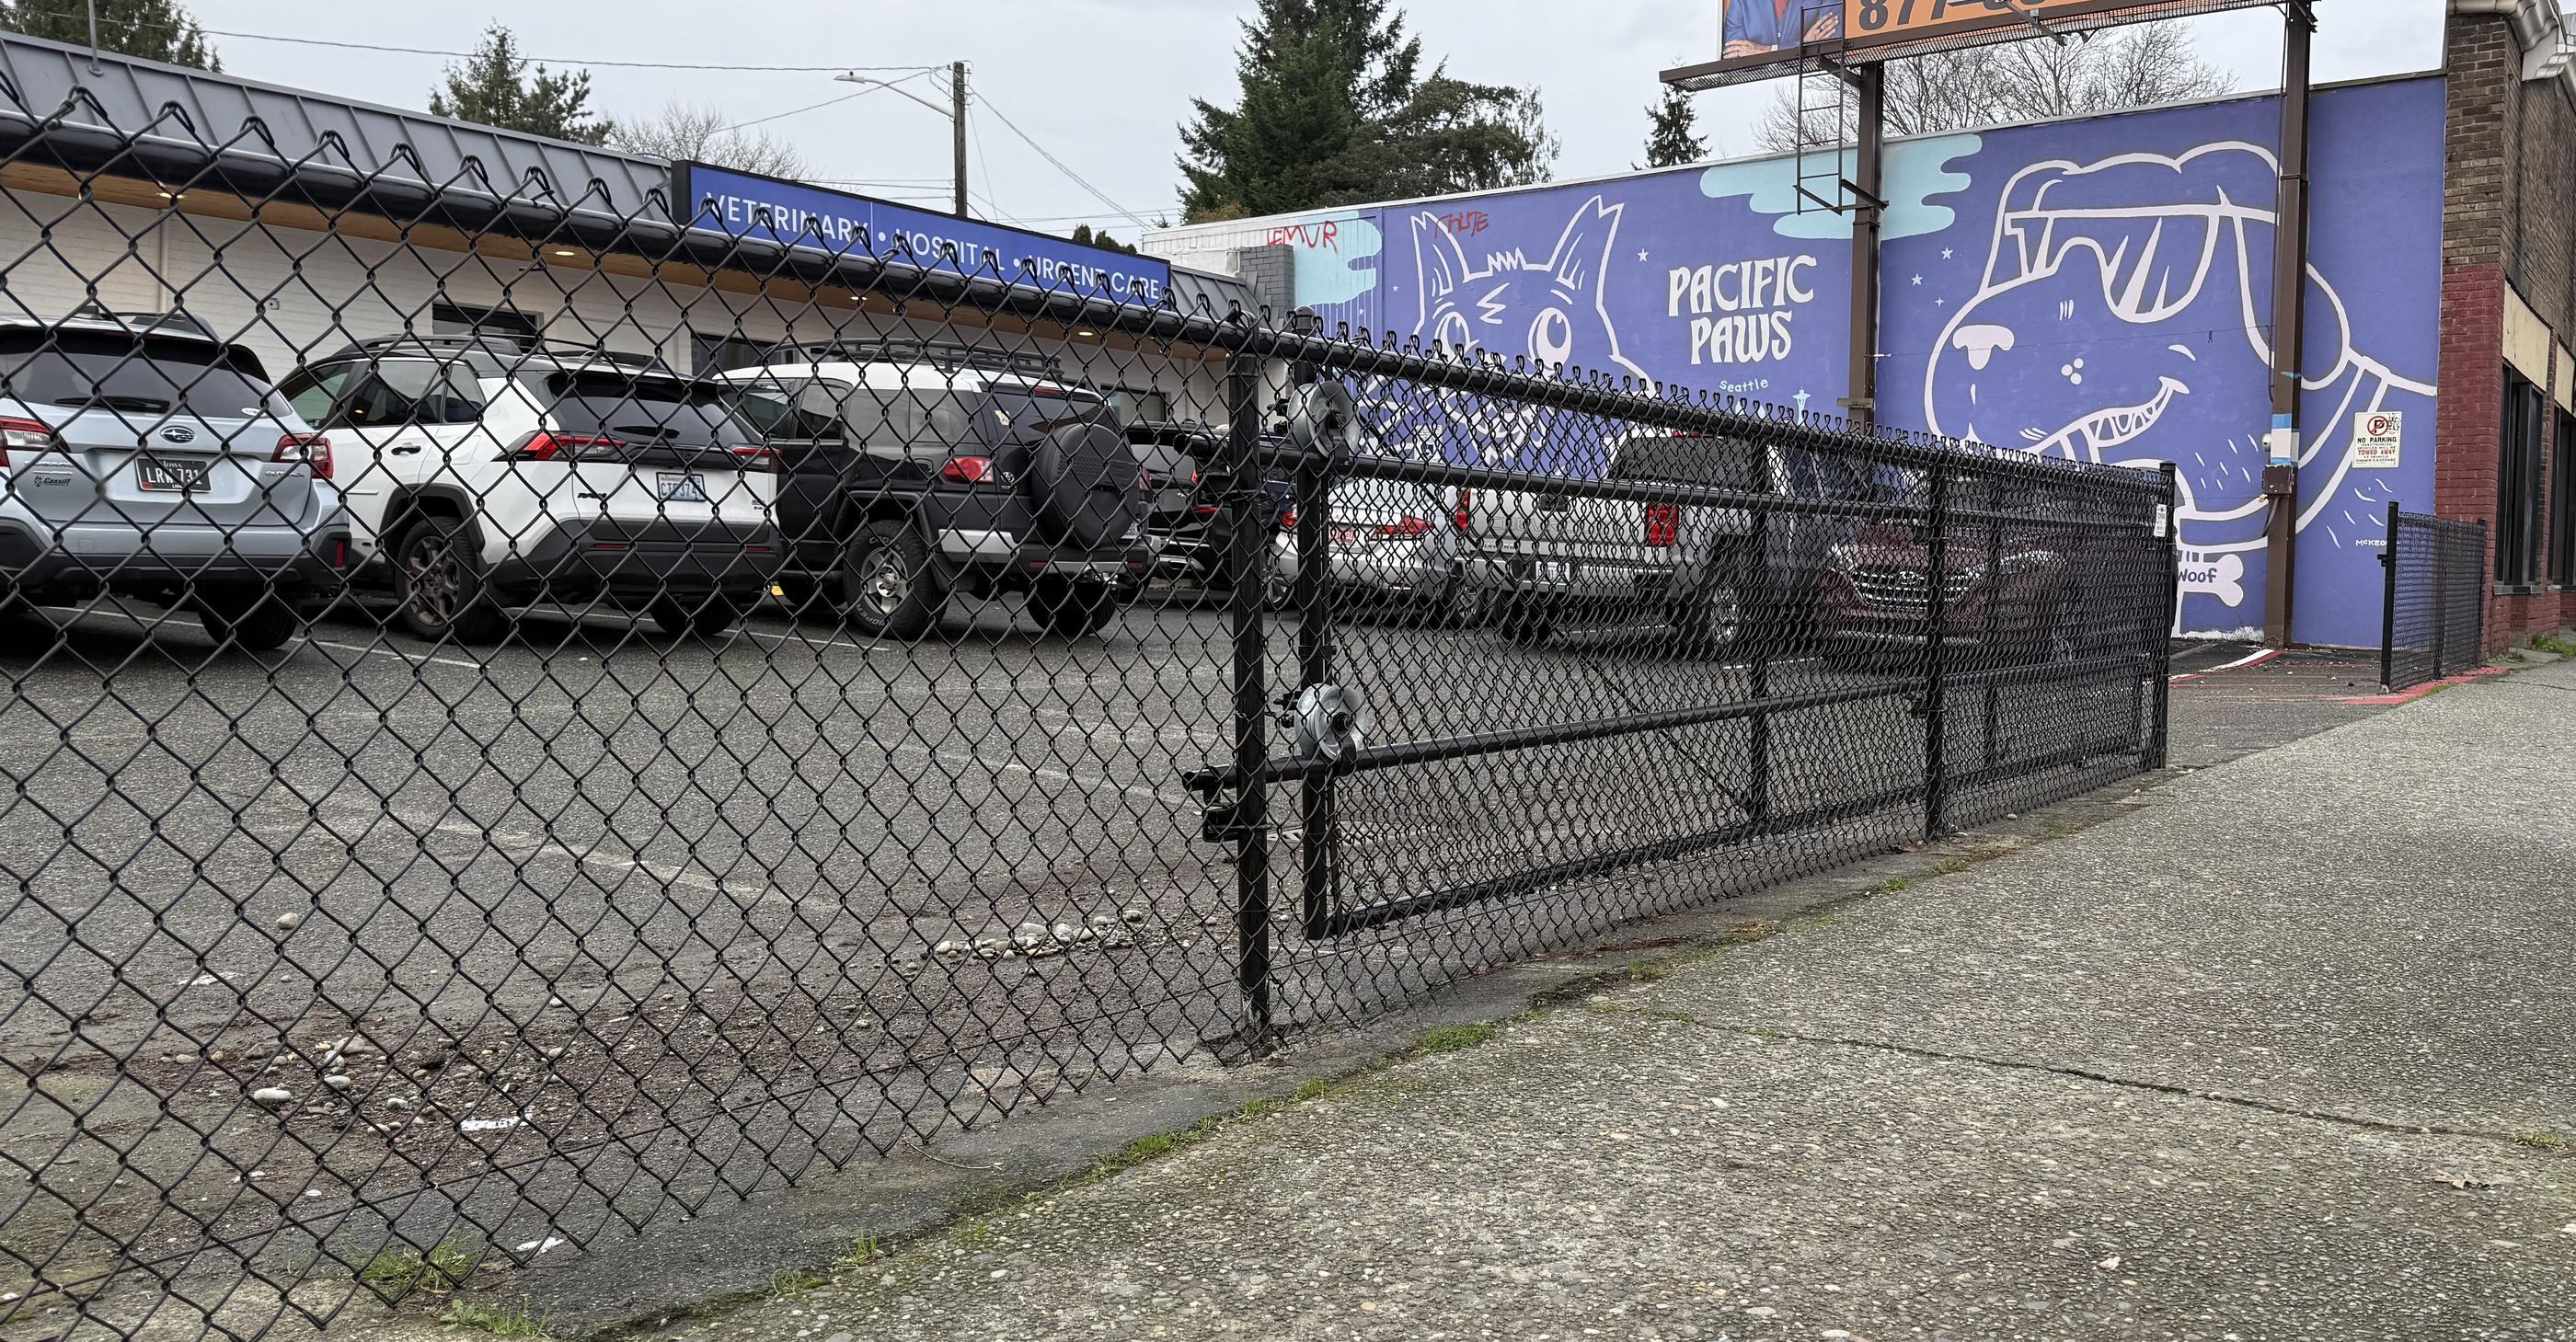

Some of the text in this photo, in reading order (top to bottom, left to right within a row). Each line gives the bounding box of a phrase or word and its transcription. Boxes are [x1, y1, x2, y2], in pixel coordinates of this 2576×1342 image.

[707, 192, 1159, 301] VETERINARY HOSPITAL URGENT CARE
[1668, 254, 1818, 317] PACIFIC
[1690, 309, 1793, 365] PAWS
